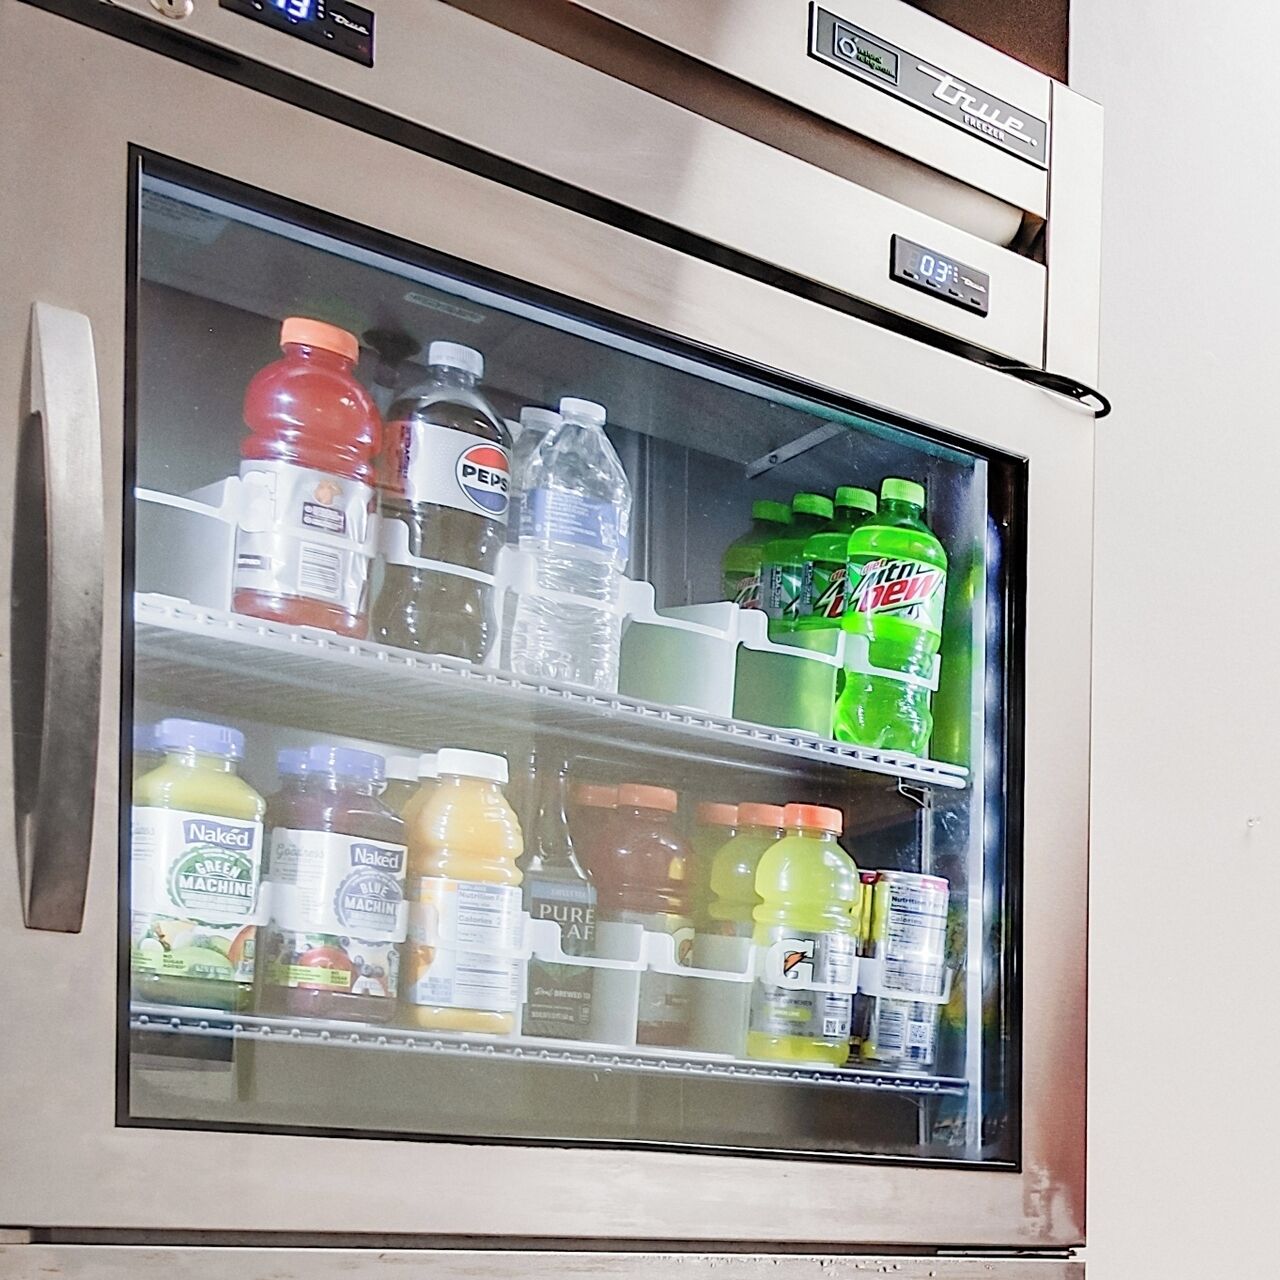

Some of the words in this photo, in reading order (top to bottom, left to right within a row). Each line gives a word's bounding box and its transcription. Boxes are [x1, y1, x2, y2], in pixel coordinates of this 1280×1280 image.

[963, 114, 1006, 142] FREEZER
[461, 462, 509, 492] PEPS
[189, 822, 249, 847] Naked
[354, 847, 399, 869] Naked
[194, 860, 242, 879] GREEN
[179, 875, 254, 897] MACHINE
[359, 882, 389, 898] BLUE
[344, 896, 397, 916] MACHIN
[539, 903, 595, 924] PURE
